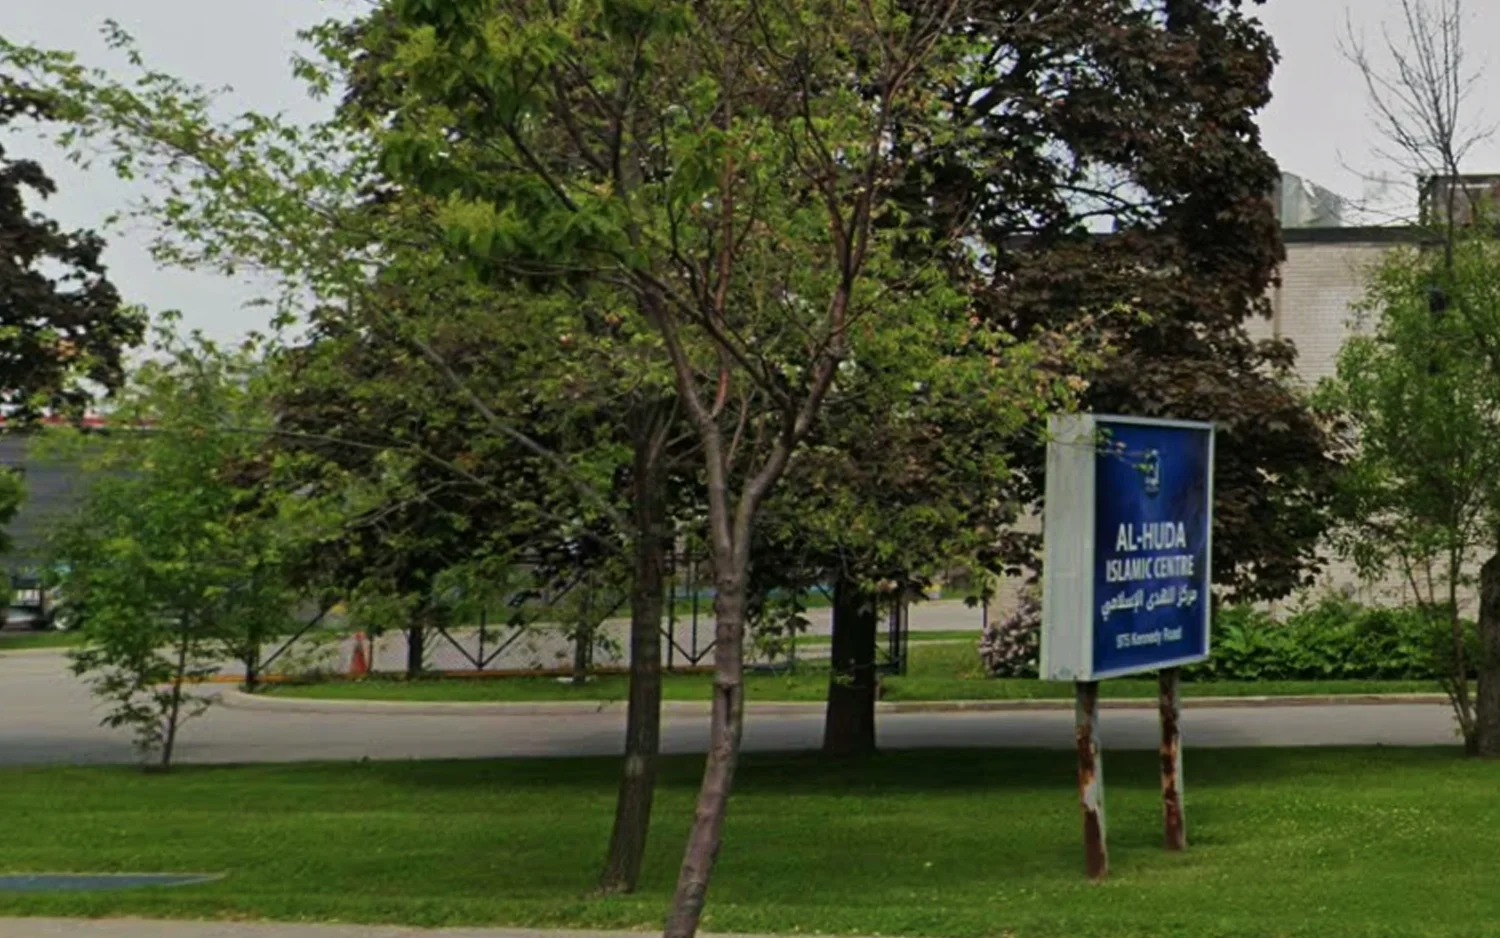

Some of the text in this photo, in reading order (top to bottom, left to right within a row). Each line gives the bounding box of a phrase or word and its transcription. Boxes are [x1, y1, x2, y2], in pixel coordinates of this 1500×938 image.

[1116, 522, 1186, 551] AL-HUDA
[1106, 555, 1194, 582] ISLAMIC CENTRE
[1131, 630, 1161, 646] Kennedy
[1163, 627, 1182, 640] Road
